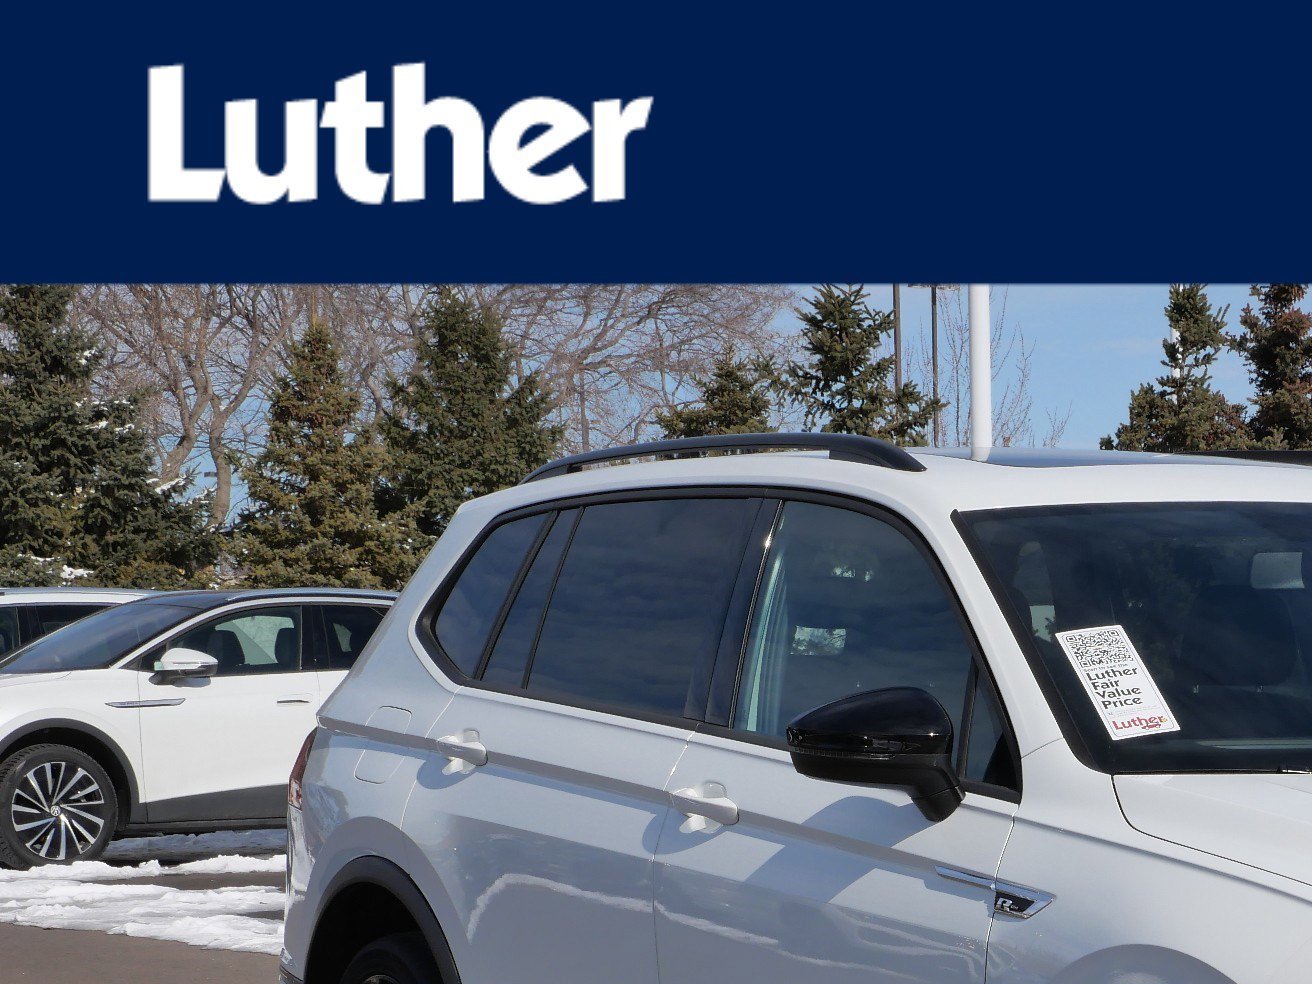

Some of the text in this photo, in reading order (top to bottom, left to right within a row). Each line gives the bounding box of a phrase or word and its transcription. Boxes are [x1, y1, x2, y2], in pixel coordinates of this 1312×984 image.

[1086, 667, 1138, 681] Luther
[1091, 679, 1121, 691] Fair
[1095, 686, 1142, 699] Value
[1101, 697, 1143, 709] Price
[1112, 716, 1164, 730] Luther
